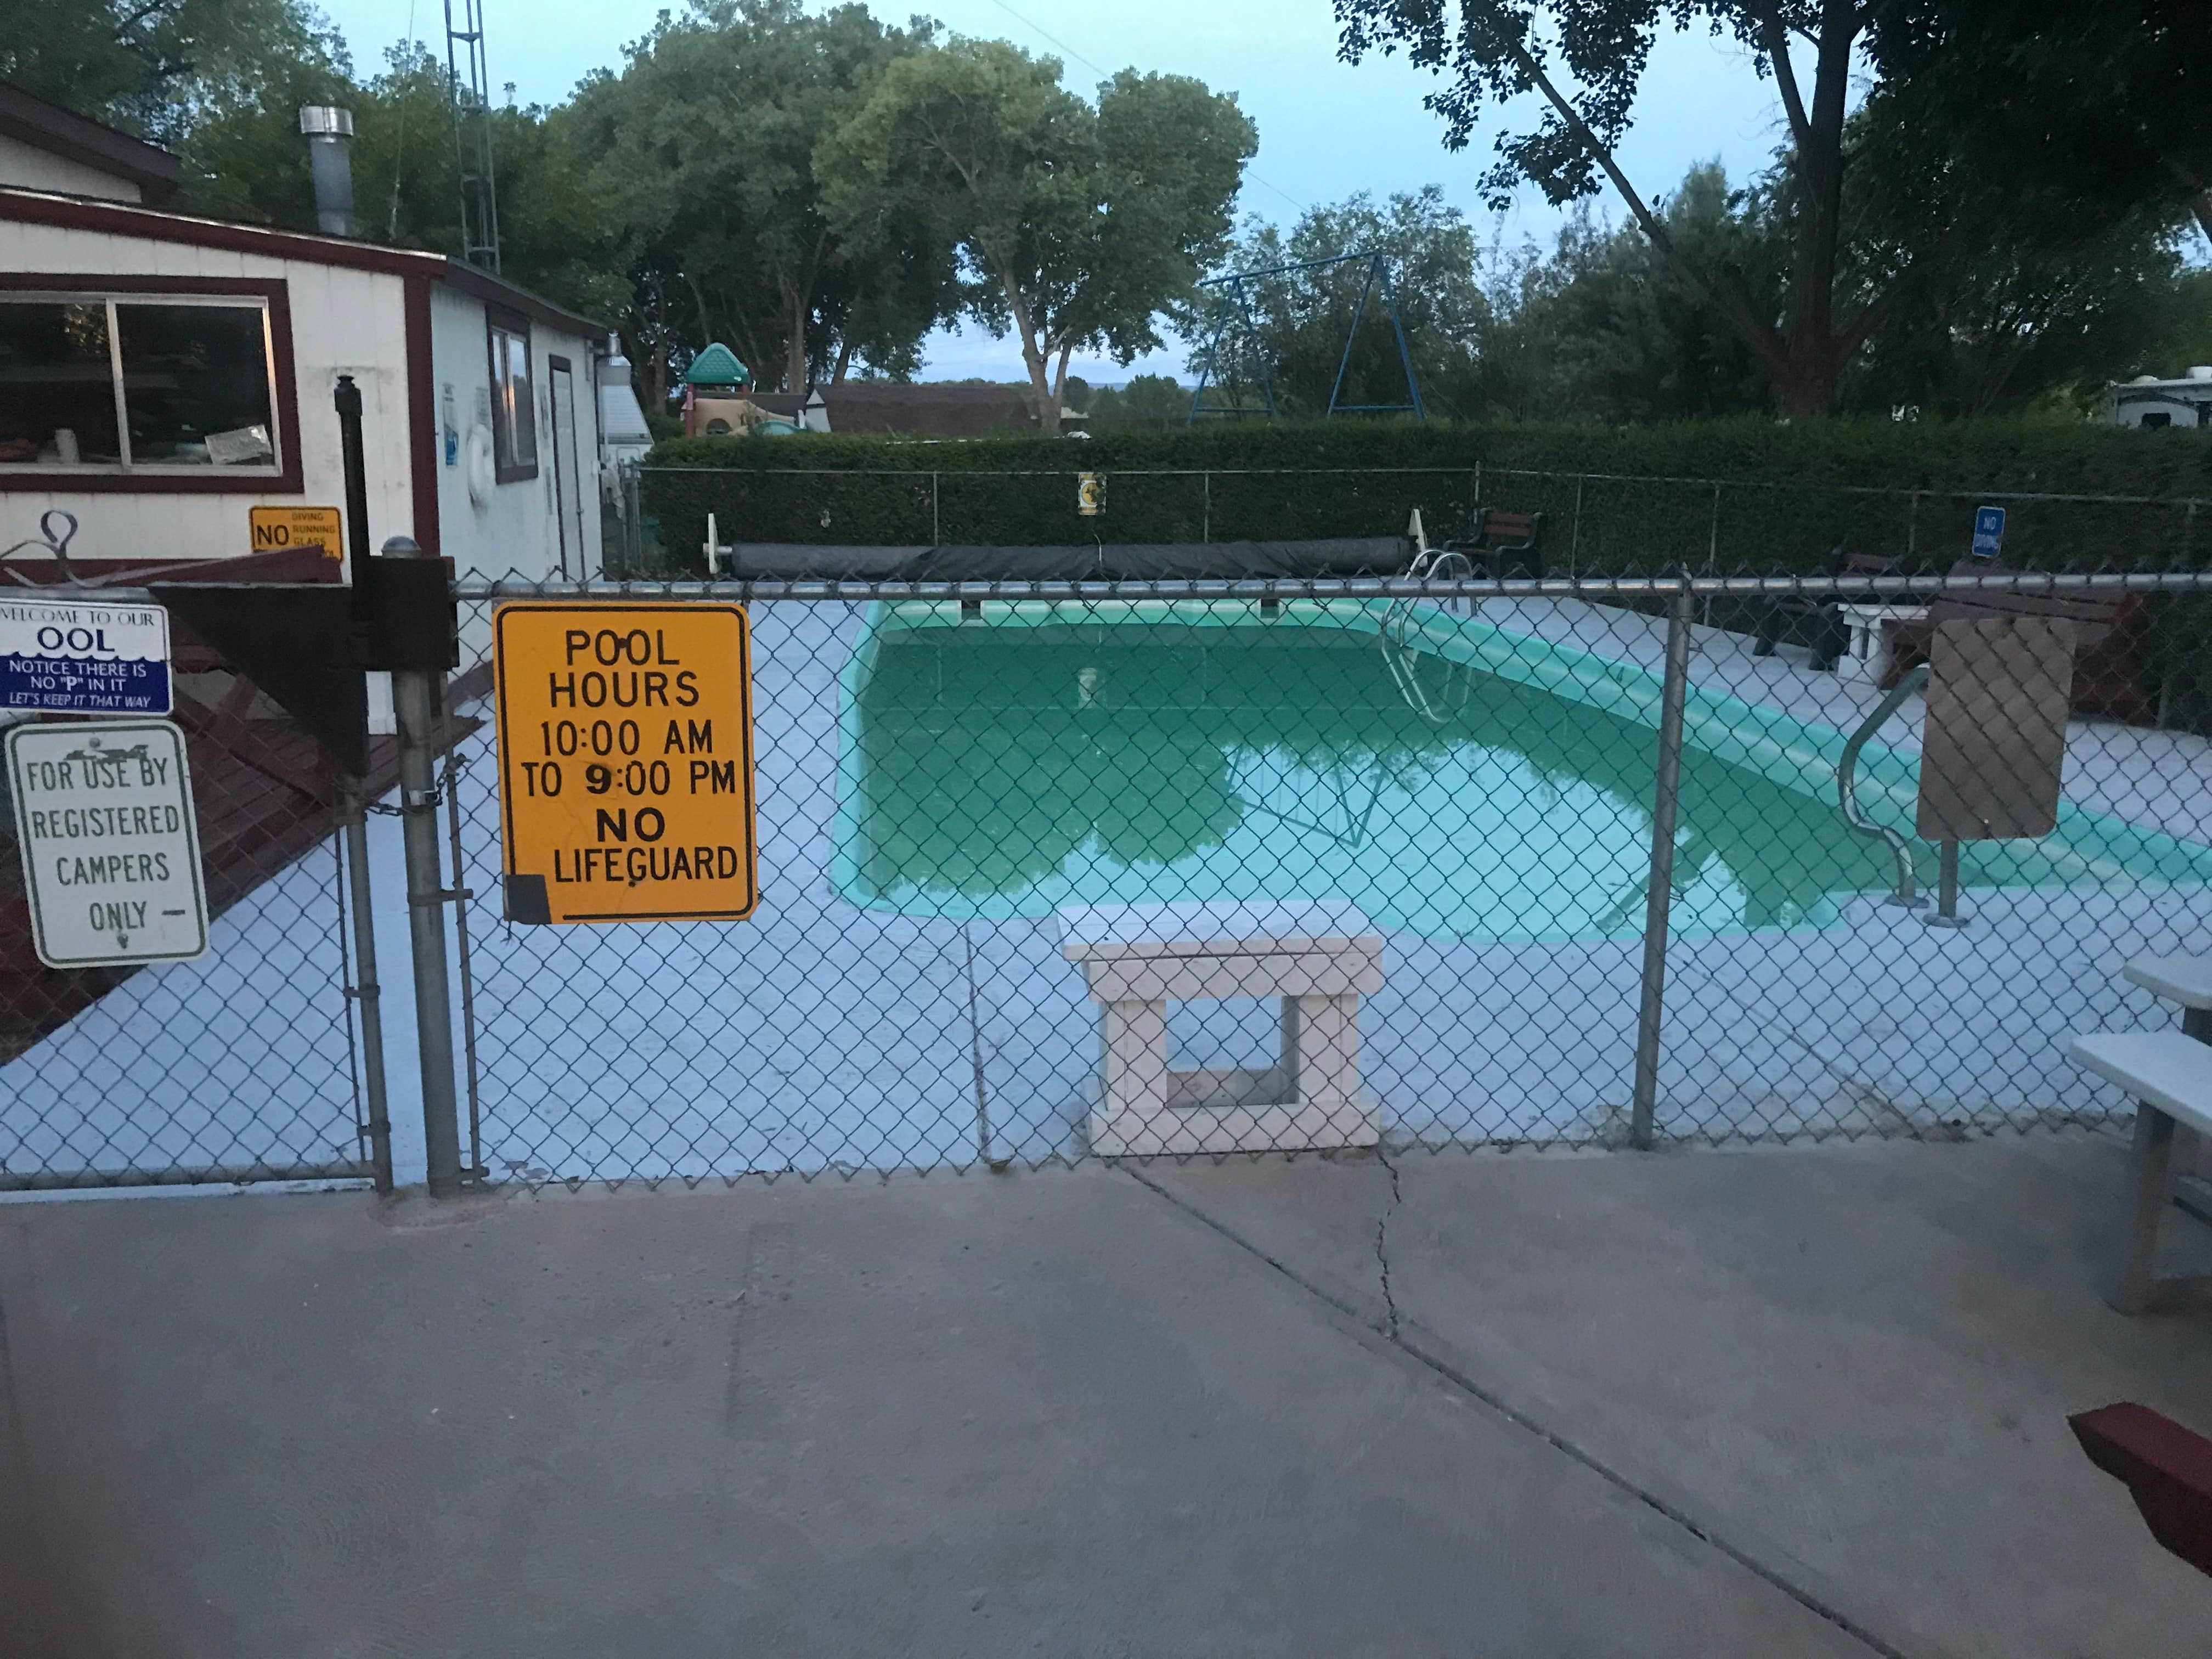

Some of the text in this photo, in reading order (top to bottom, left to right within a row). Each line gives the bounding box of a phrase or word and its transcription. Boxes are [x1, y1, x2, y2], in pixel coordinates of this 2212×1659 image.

[292, 512, 324, 521] DIVING
[293, 524, 336, 533] RUNNING
[1983, 516, 1996, 530] NO
[257, 524, 289, 546] NO
[294, 537, 326, 546] GLASS
[88, 611, 111, 624] TO
[118, 612, 154, 626] OUR
[37, 627, 115, 652] OOL
[566, 629, 680, 666] POOL
[9, 660, 147, 678] NOTICE THERE IS
[31, 676, 127, 692] NO "P" IN IT
[549, 670, 699, 708] HOURS
[9, 692, 152, 708] LET'S KEEP IT THAT WAY
[541, 719, 713, 757] 10:00 AM
[27, 757, 168, 791] FOR USE BY
[521, 760, 736, 797] TO 9:00 PM
[31, 805, 180, 839] REGISTERED
[596, 806, 666, 843] NO
[56, 852, 171, 886] CAMPERS
[554, 845, 738, 882] LIFEGUARD
[89, 901, 147, 931] ONLY
